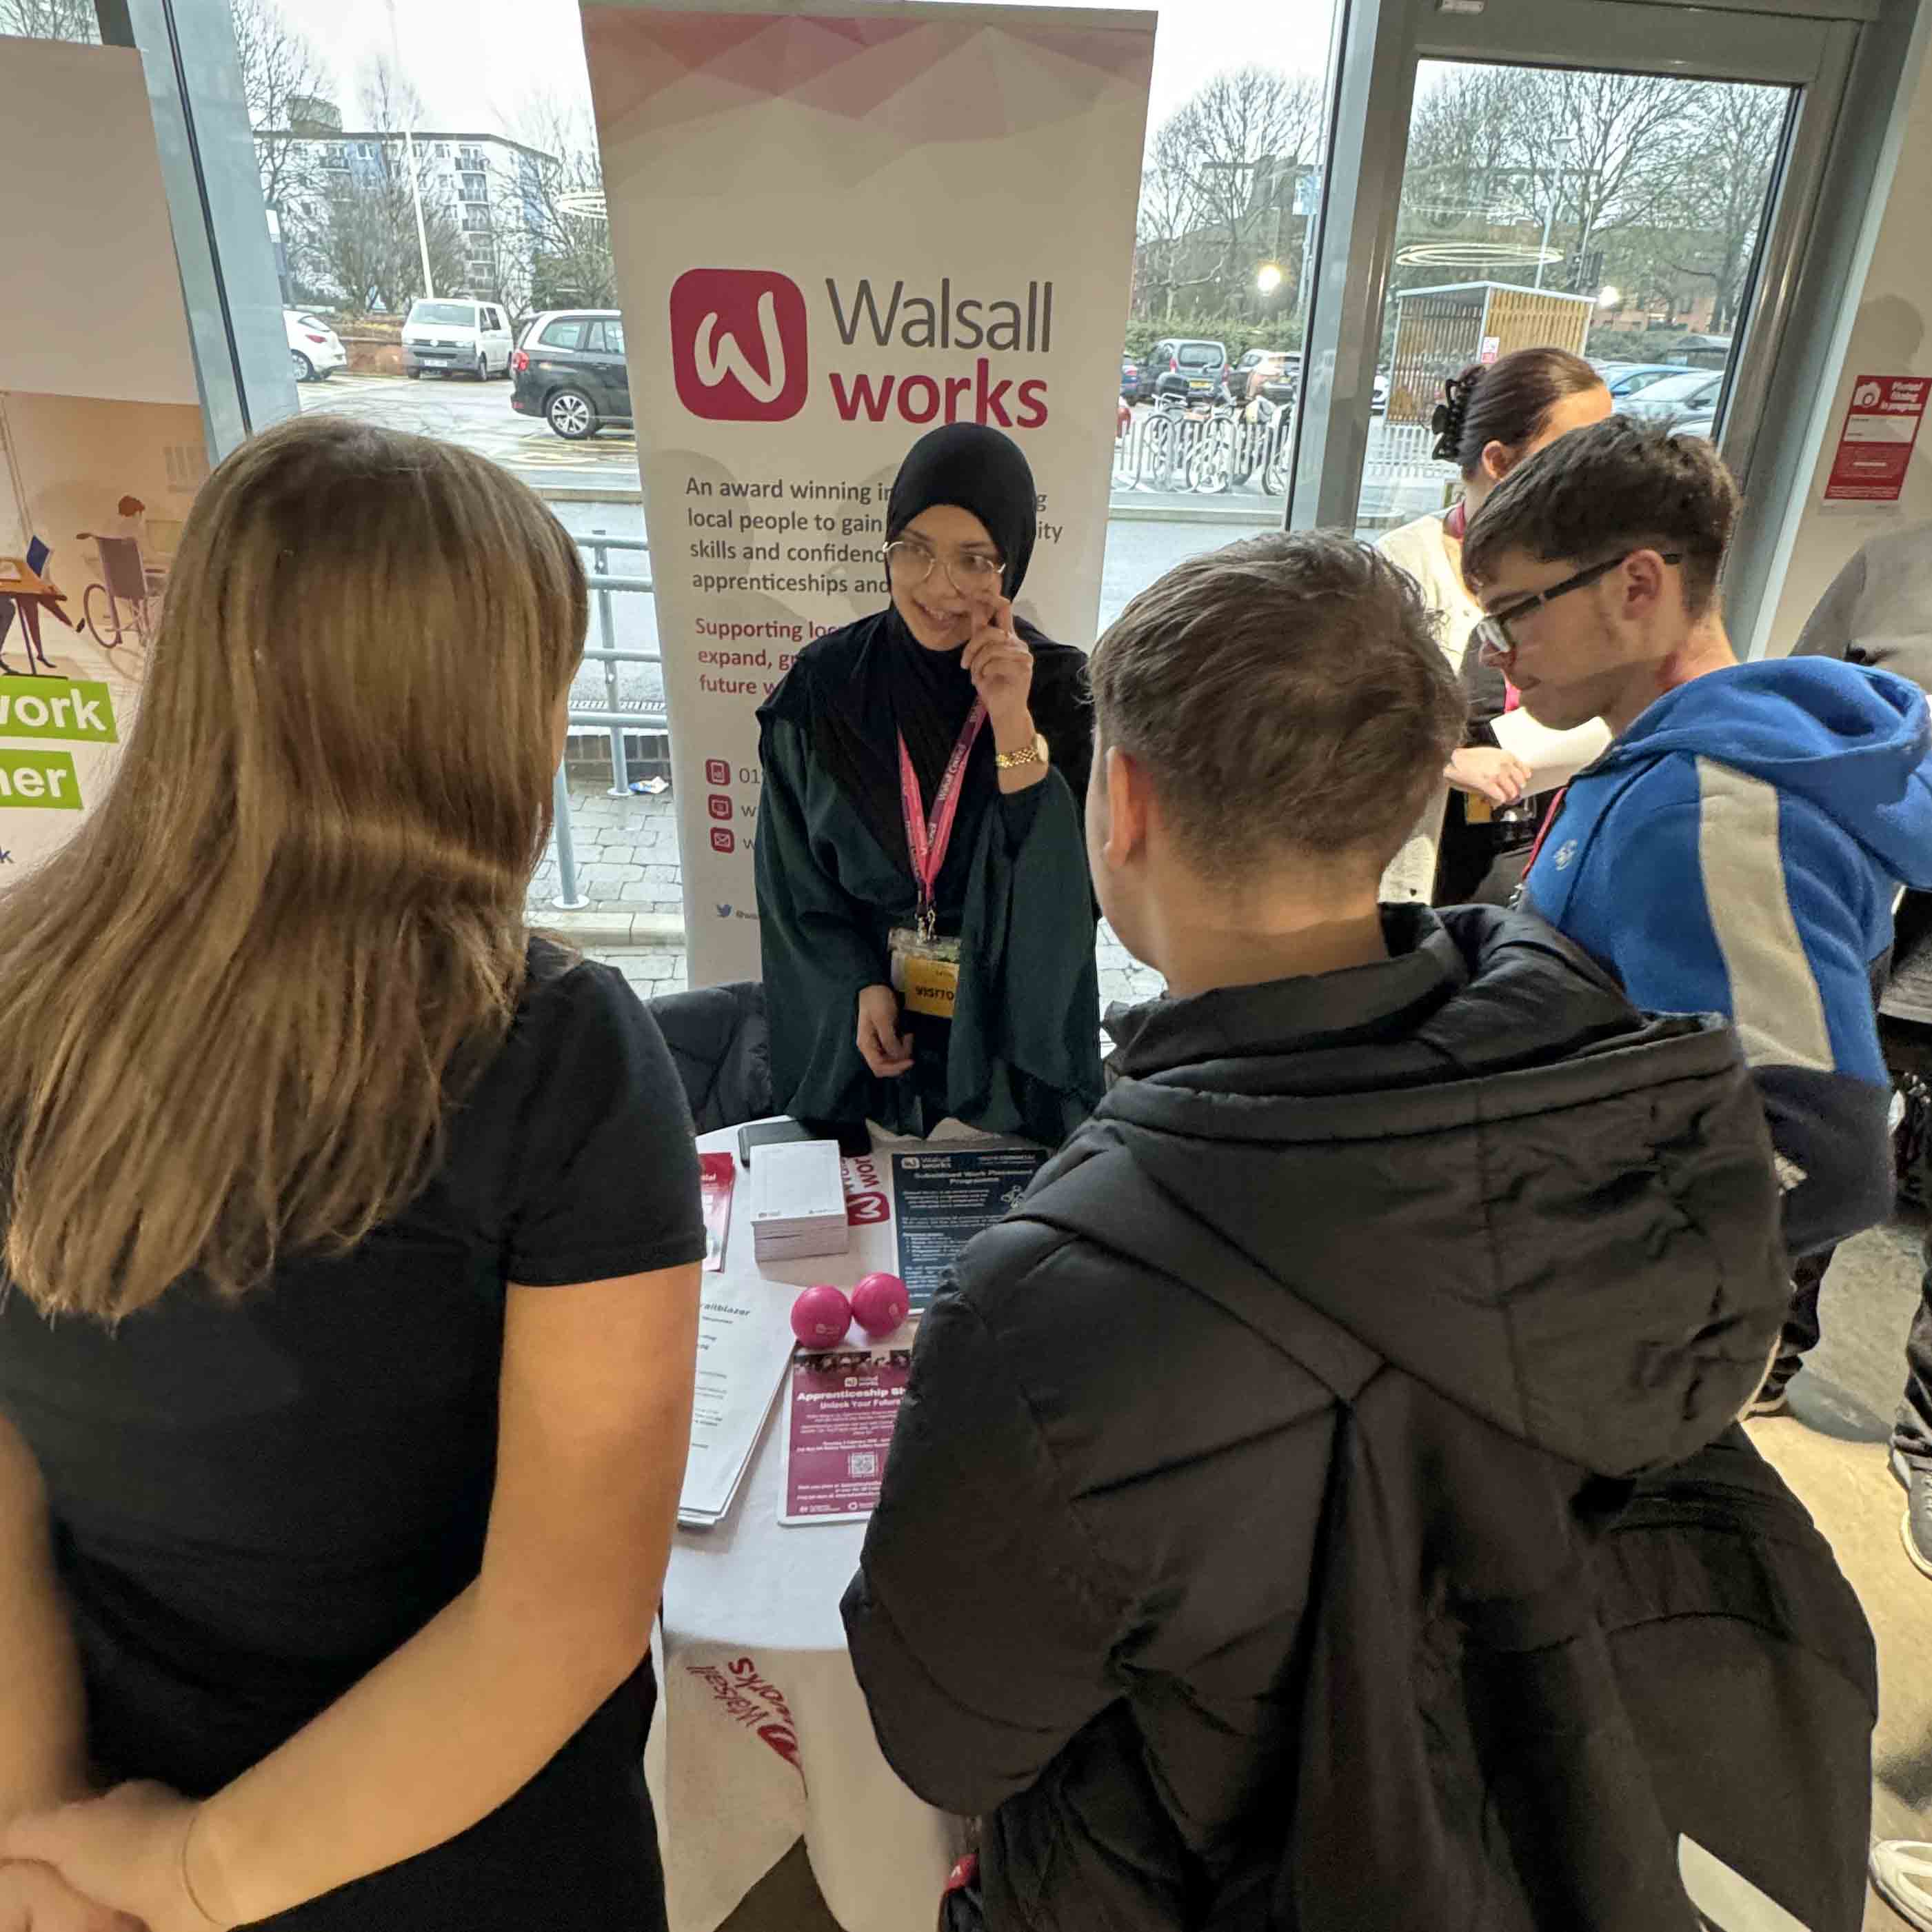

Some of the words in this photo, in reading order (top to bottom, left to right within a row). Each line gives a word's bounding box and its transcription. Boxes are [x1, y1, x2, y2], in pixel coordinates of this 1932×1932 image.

[825, 277, 1053, 352] Walsall
[828, 357, 1048, 429] works
[685, 476, 712, 496] An
[719, 479, 783, 498] award
[790, 481, 872, 505] winning
[688, 507, 732, 528] local
[739, 511, 808, 534] people
[815, 516, 835, 531] to
[841, 514, 883, 536] gain
[690, 539, 736, 559] skills
[743, 543, 780, 560] and
[787, 543, 885, 563] confidenc
[692, 574, 847, 596] apprenticeships
[694, 618, 802, 642] Supporting
[698, 649, 773, 670] expand,
[699, 674, 757, 695] future
[916, 985, 955, 1000] VISITO
[797, 1388, 888, 1402] Apprenticeship
